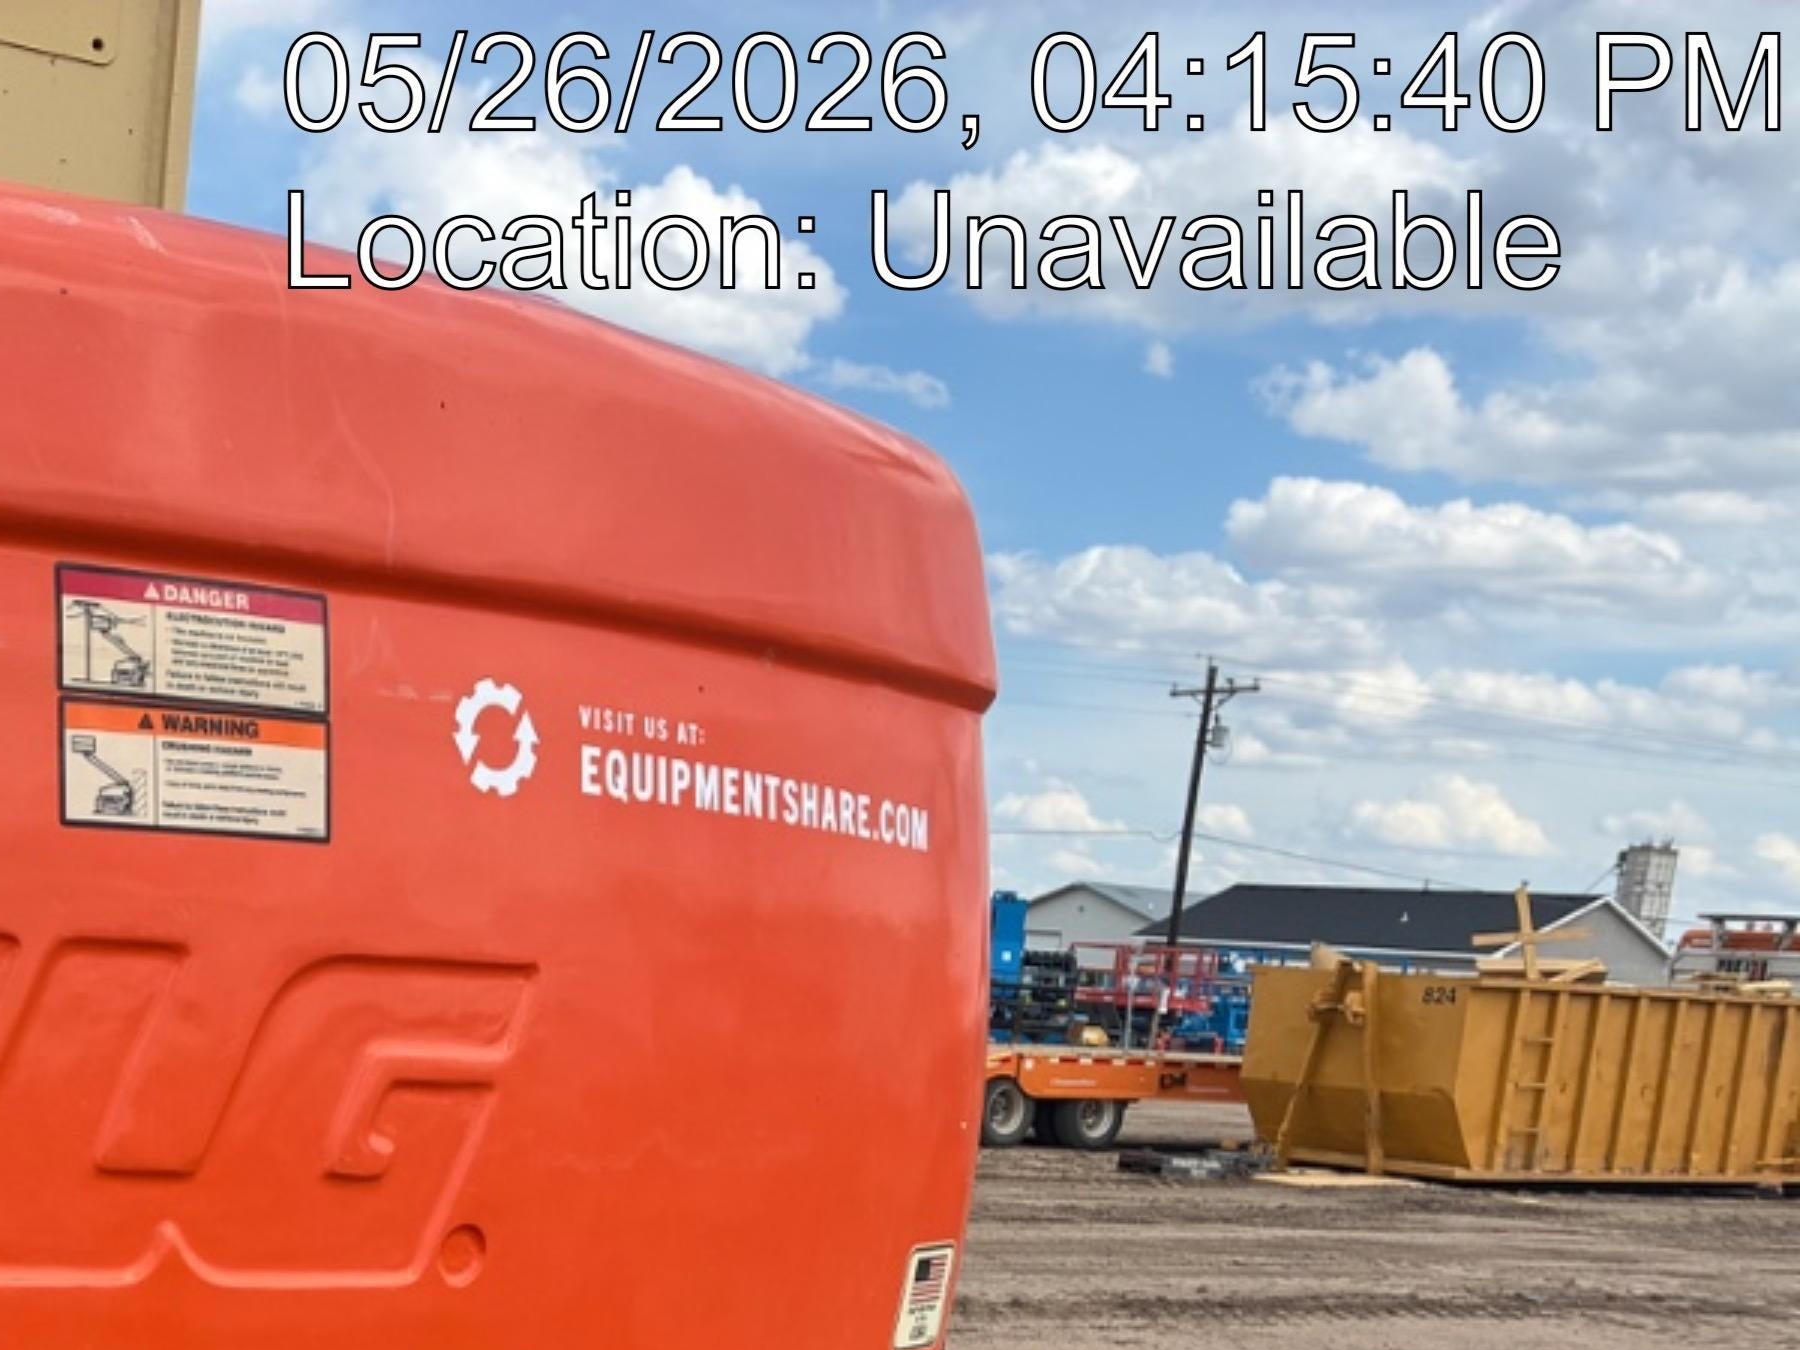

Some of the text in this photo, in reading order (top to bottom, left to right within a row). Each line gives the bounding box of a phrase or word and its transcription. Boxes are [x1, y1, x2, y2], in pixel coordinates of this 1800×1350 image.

[163, 584, 250, 610] DANGER
[161, 713, 260, 738] WARNING
[578, 705, 707, 746] VISIT US AT:
[579, 743, 930, 852] EQUIPMENTSHARE.COM
[1421, 985, 1457, 1006] 824
